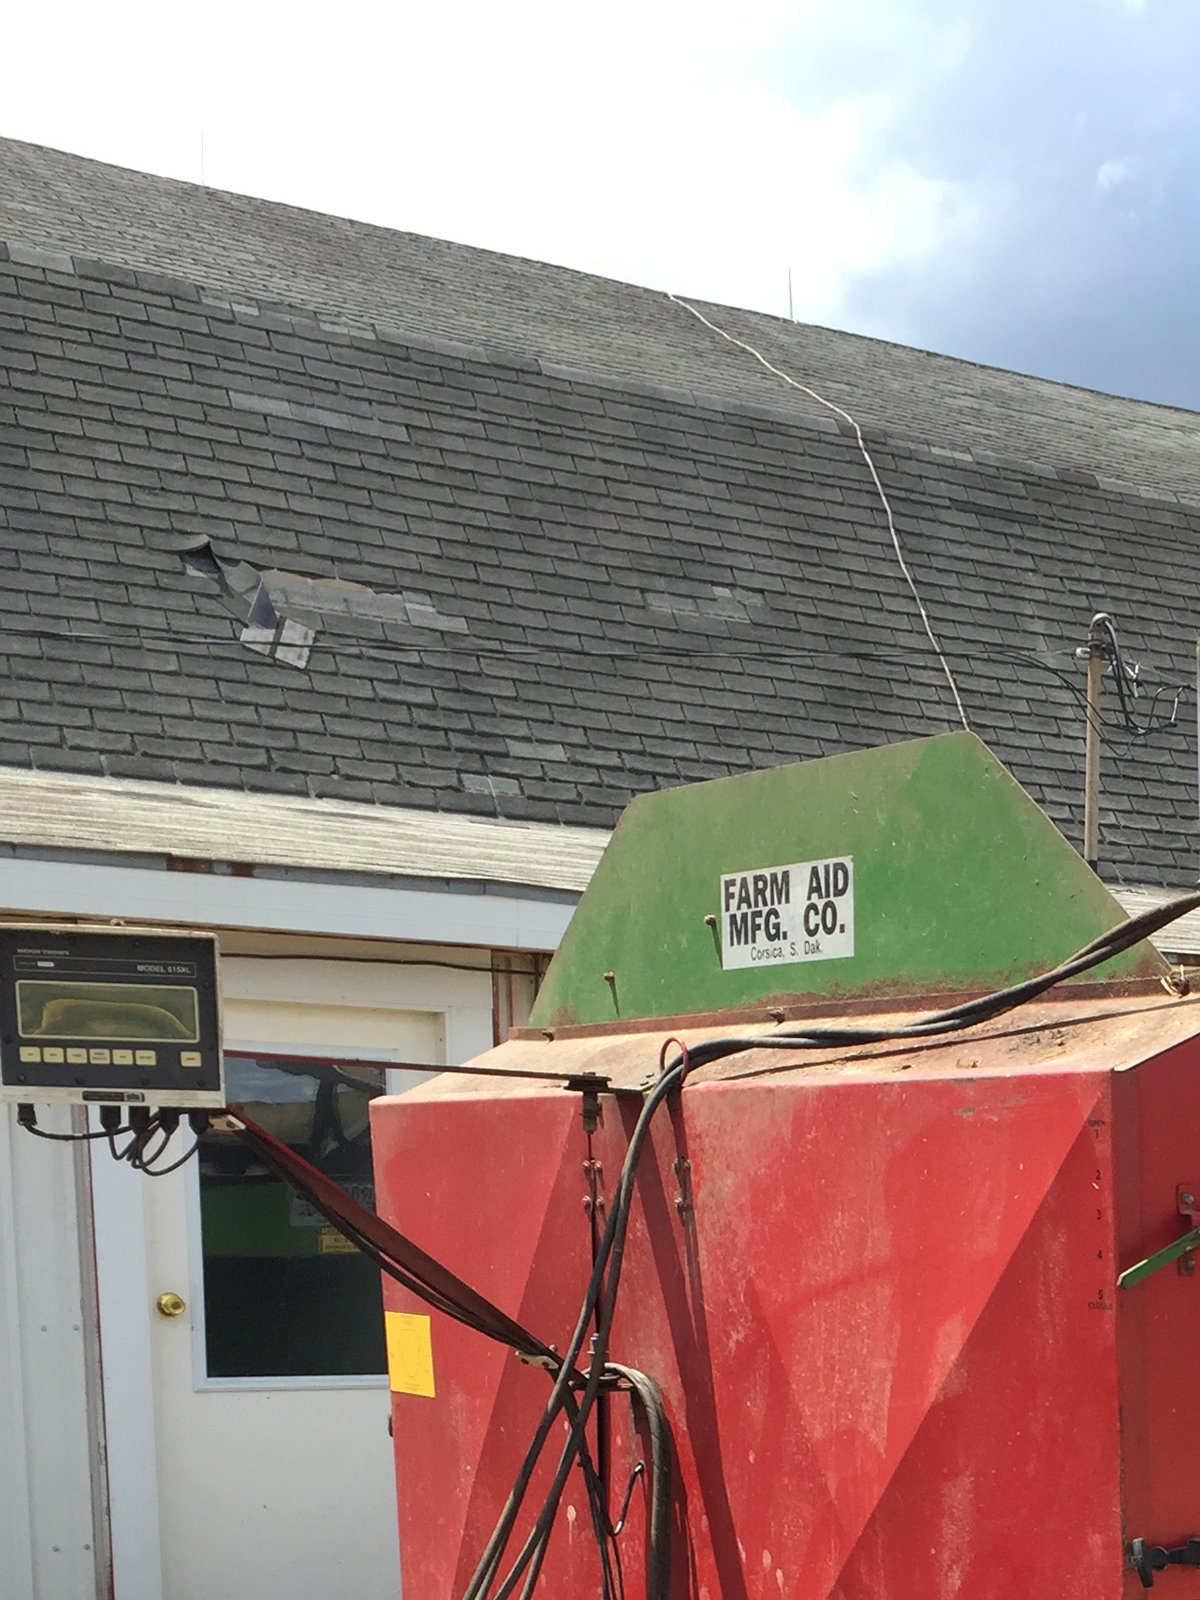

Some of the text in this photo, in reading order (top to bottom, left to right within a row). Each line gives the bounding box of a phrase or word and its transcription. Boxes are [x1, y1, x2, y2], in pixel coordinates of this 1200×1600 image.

[724, 862, 849, 912] FARM AID
[729, 900, 845, 947] MFG. CO.
[751, 940, 824, 961] Corsica, S. Dak.
[136, 964, 166, 973] MODEL
[1094, 1129, 1099, 1139] 1
[1095, 1169, 1101, 1180] 2
[1096, 1208, 1102, 1220] 3
[1096, 1249, 1103, 1260] 4
[1097, 1288, 1104, 1301] 5
